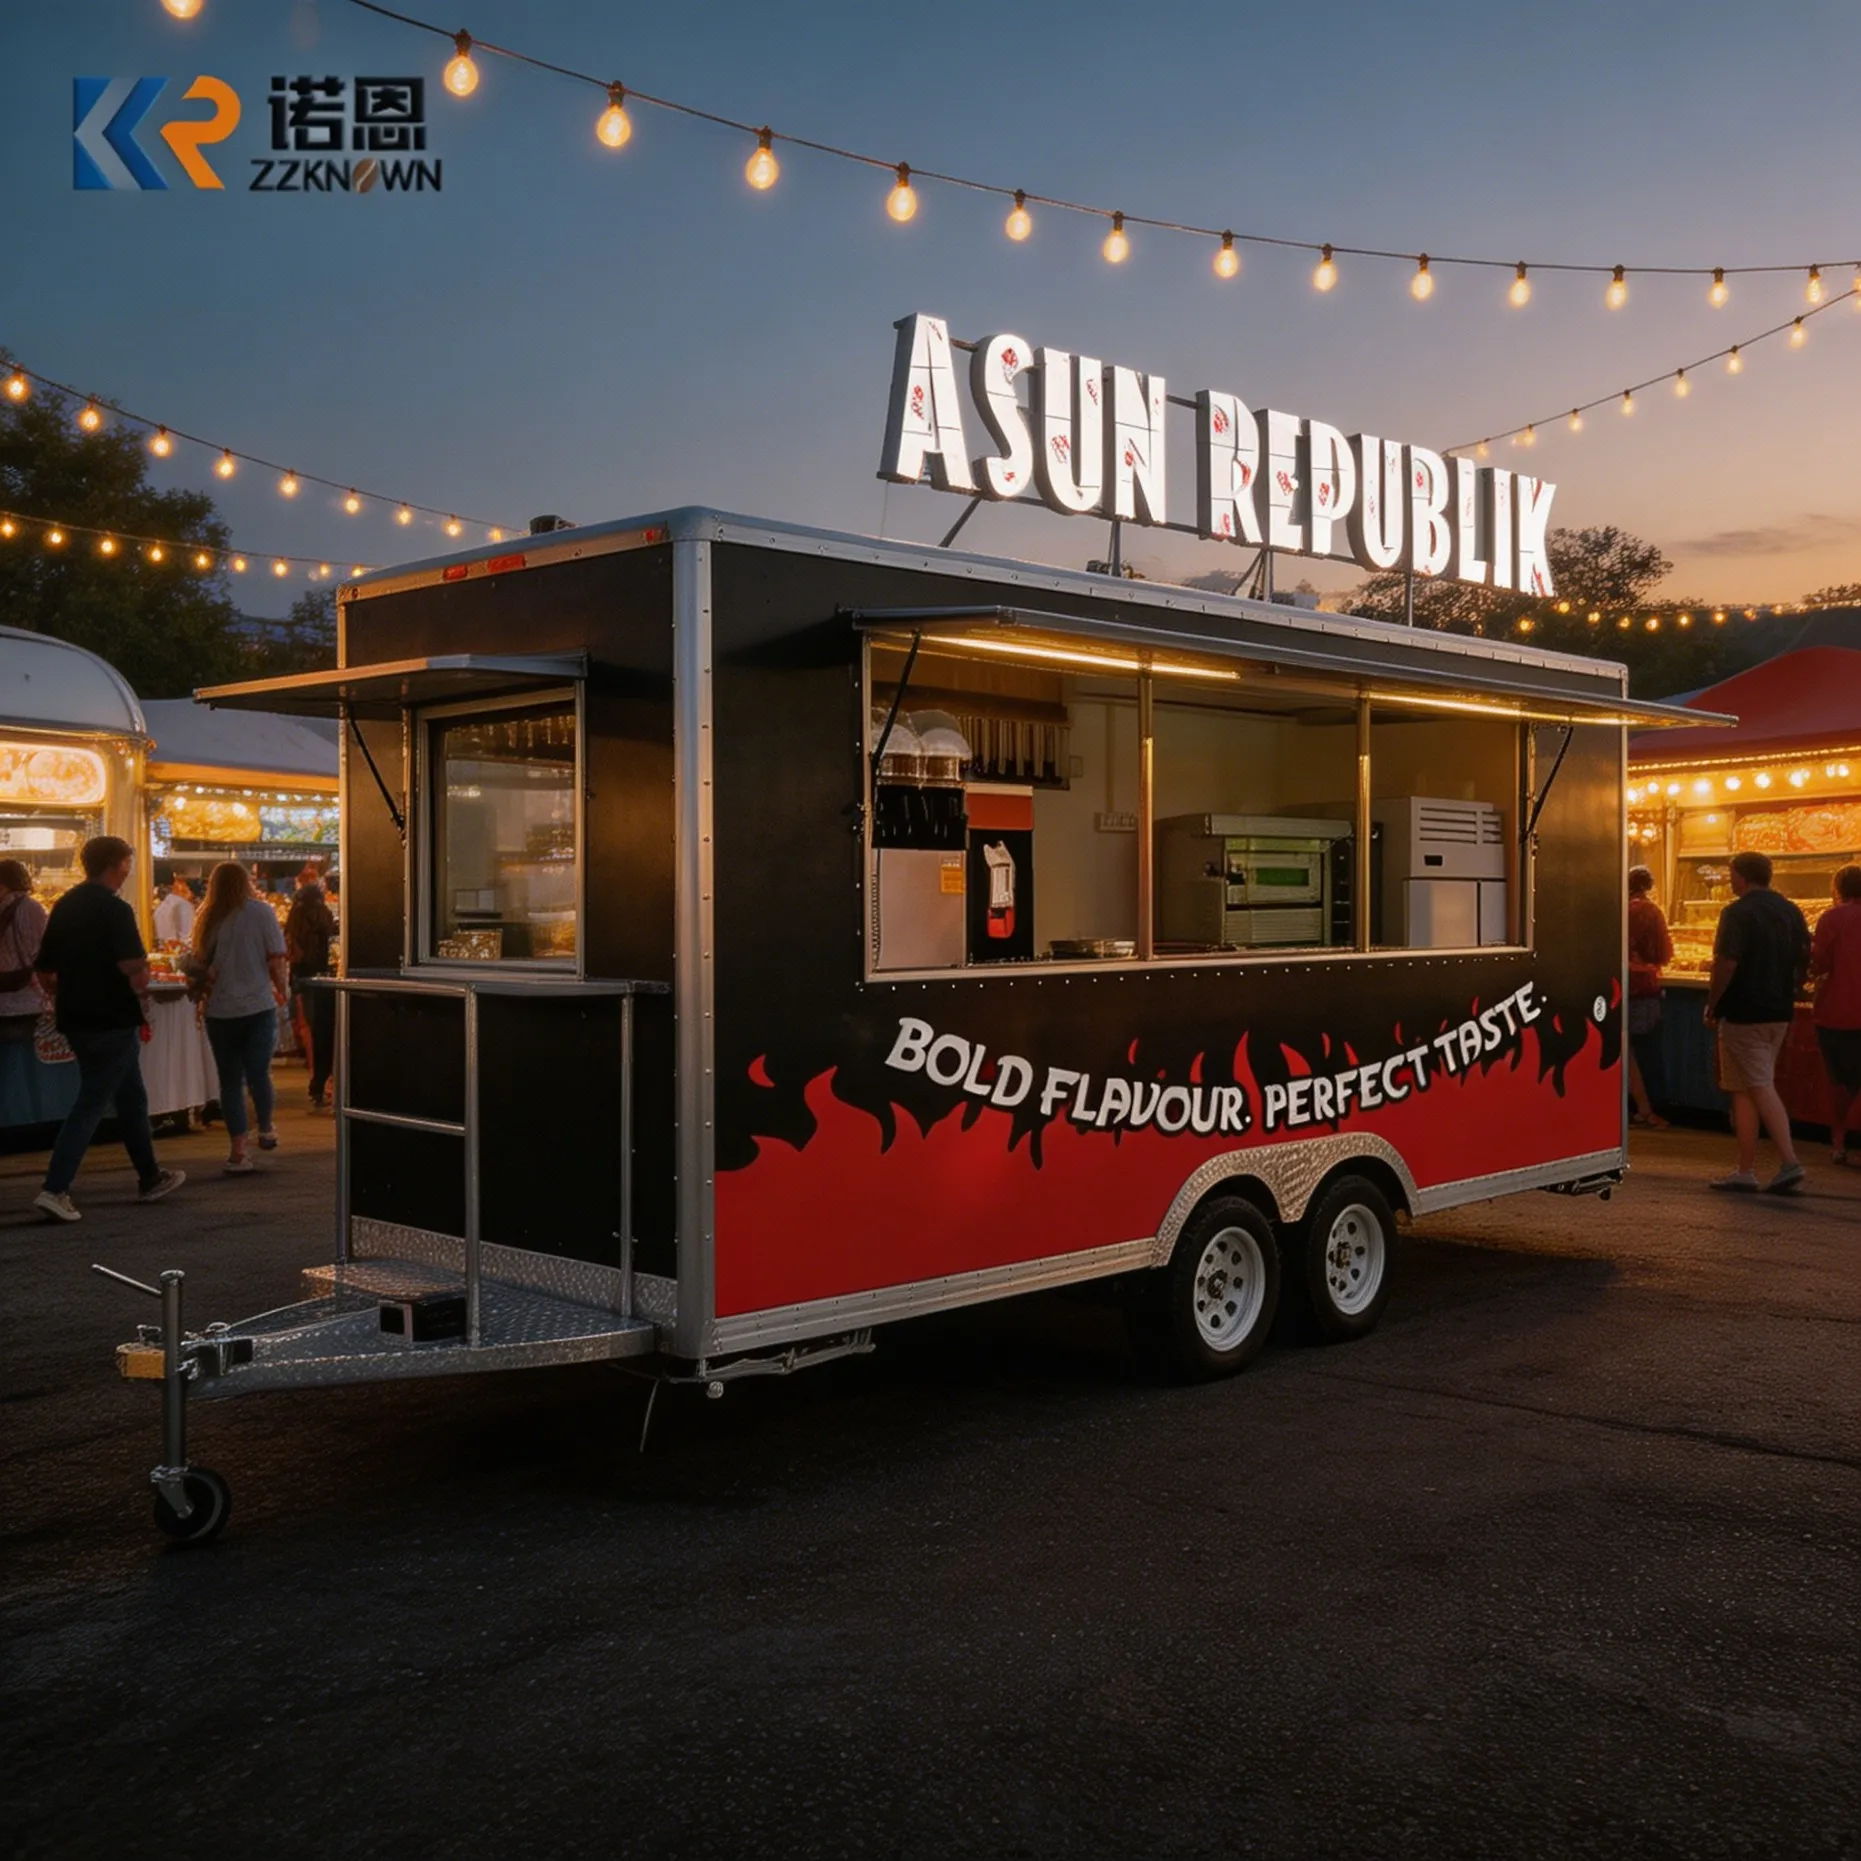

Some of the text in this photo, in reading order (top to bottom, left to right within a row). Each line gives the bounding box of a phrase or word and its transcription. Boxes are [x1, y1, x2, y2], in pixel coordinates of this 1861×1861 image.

[882, 313, 1557, 598] ASUN REPUBLIK
[885, 980, 1548, 1133] BOLD FLAVOUR. PERFECT TASTE.
